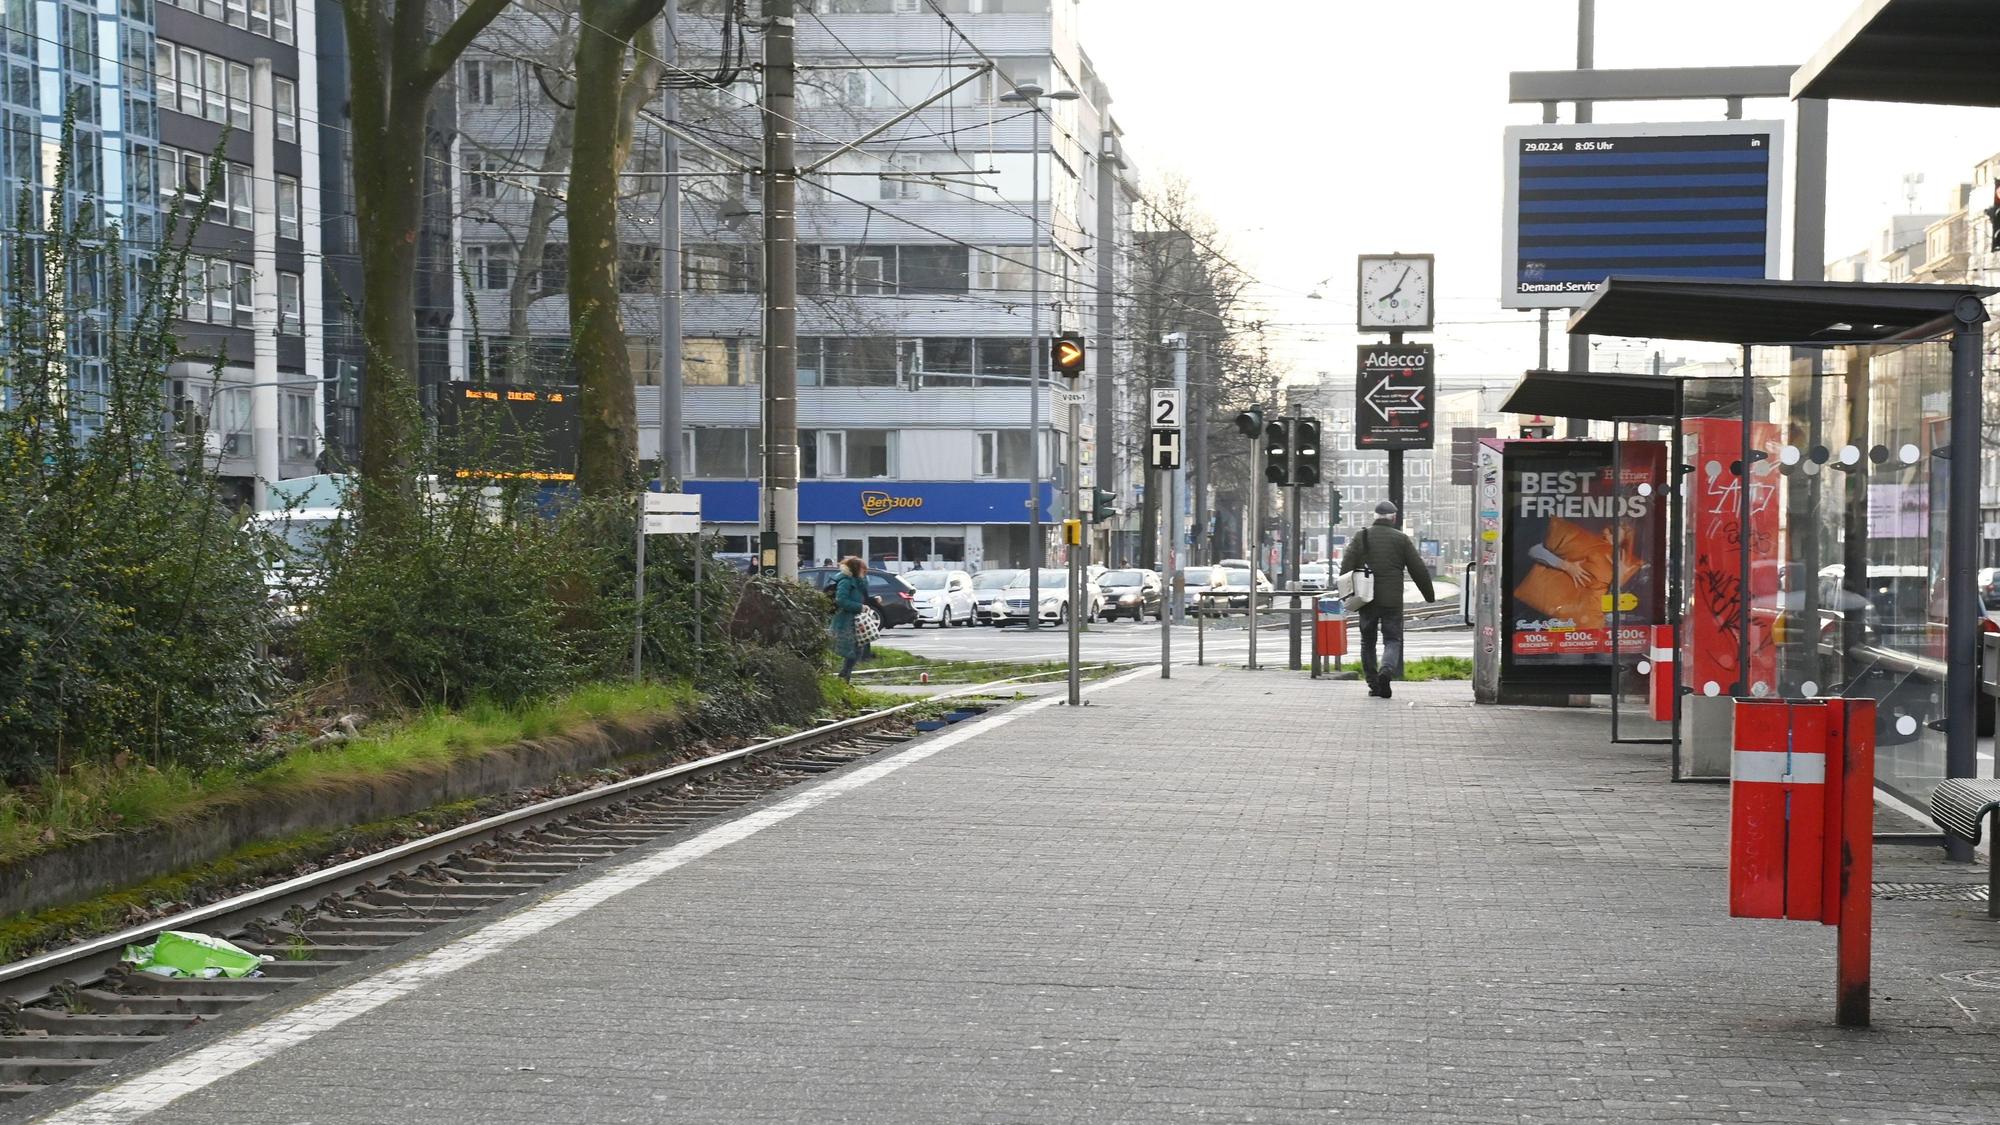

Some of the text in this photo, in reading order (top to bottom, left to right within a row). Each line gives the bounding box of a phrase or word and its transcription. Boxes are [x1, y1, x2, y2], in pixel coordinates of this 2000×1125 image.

[1525, 142, 1614, 152] 29.02.24 8:05 Uhr
[1752, 139, 1760, 147] in
[1365, 352, 1425, 367] Adecco
[1157, 399, 1174, 424] 2
[1152, 433, 1179, 466] H
[1521, 472, 1595, 494] BEST
